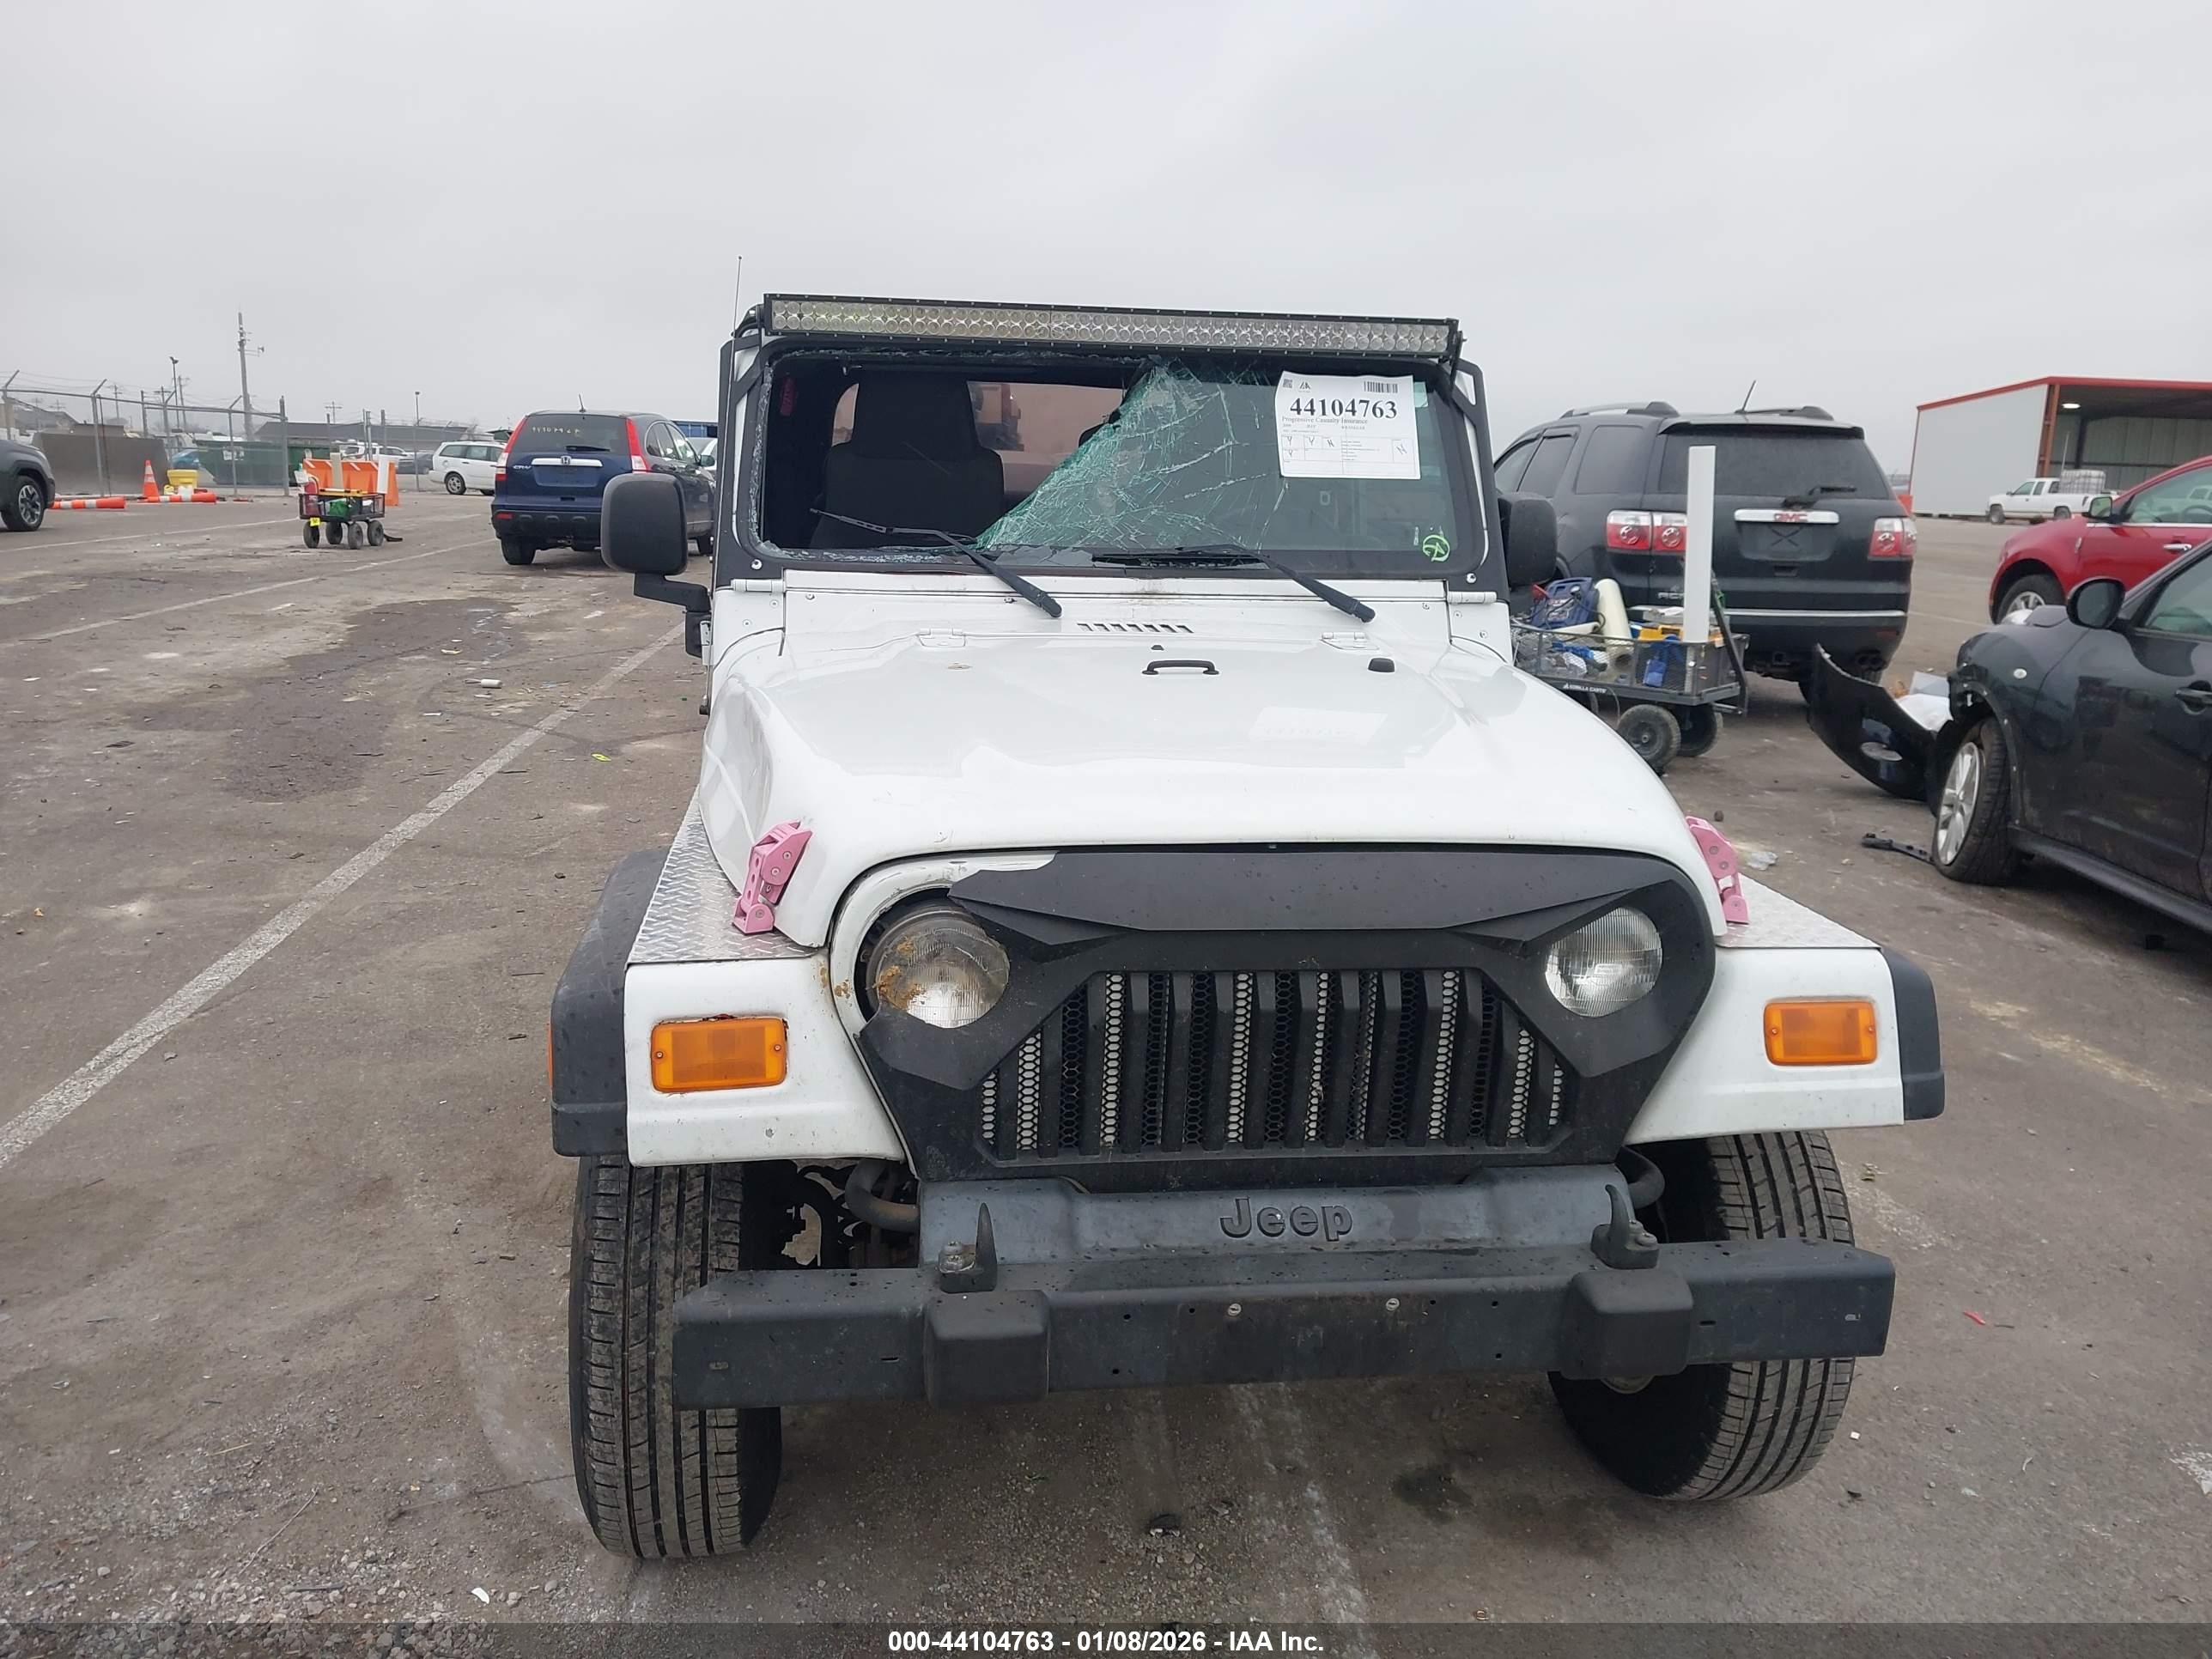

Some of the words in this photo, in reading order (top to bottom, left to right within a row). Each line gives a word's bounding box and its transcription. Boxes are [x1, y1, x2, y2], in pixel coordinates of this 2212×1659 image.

[1290, 398, 1398, 419] 44104763
[1773, 513, 1808, 523] GMC
[1219, 1197, 1352, 1242] Jeep
